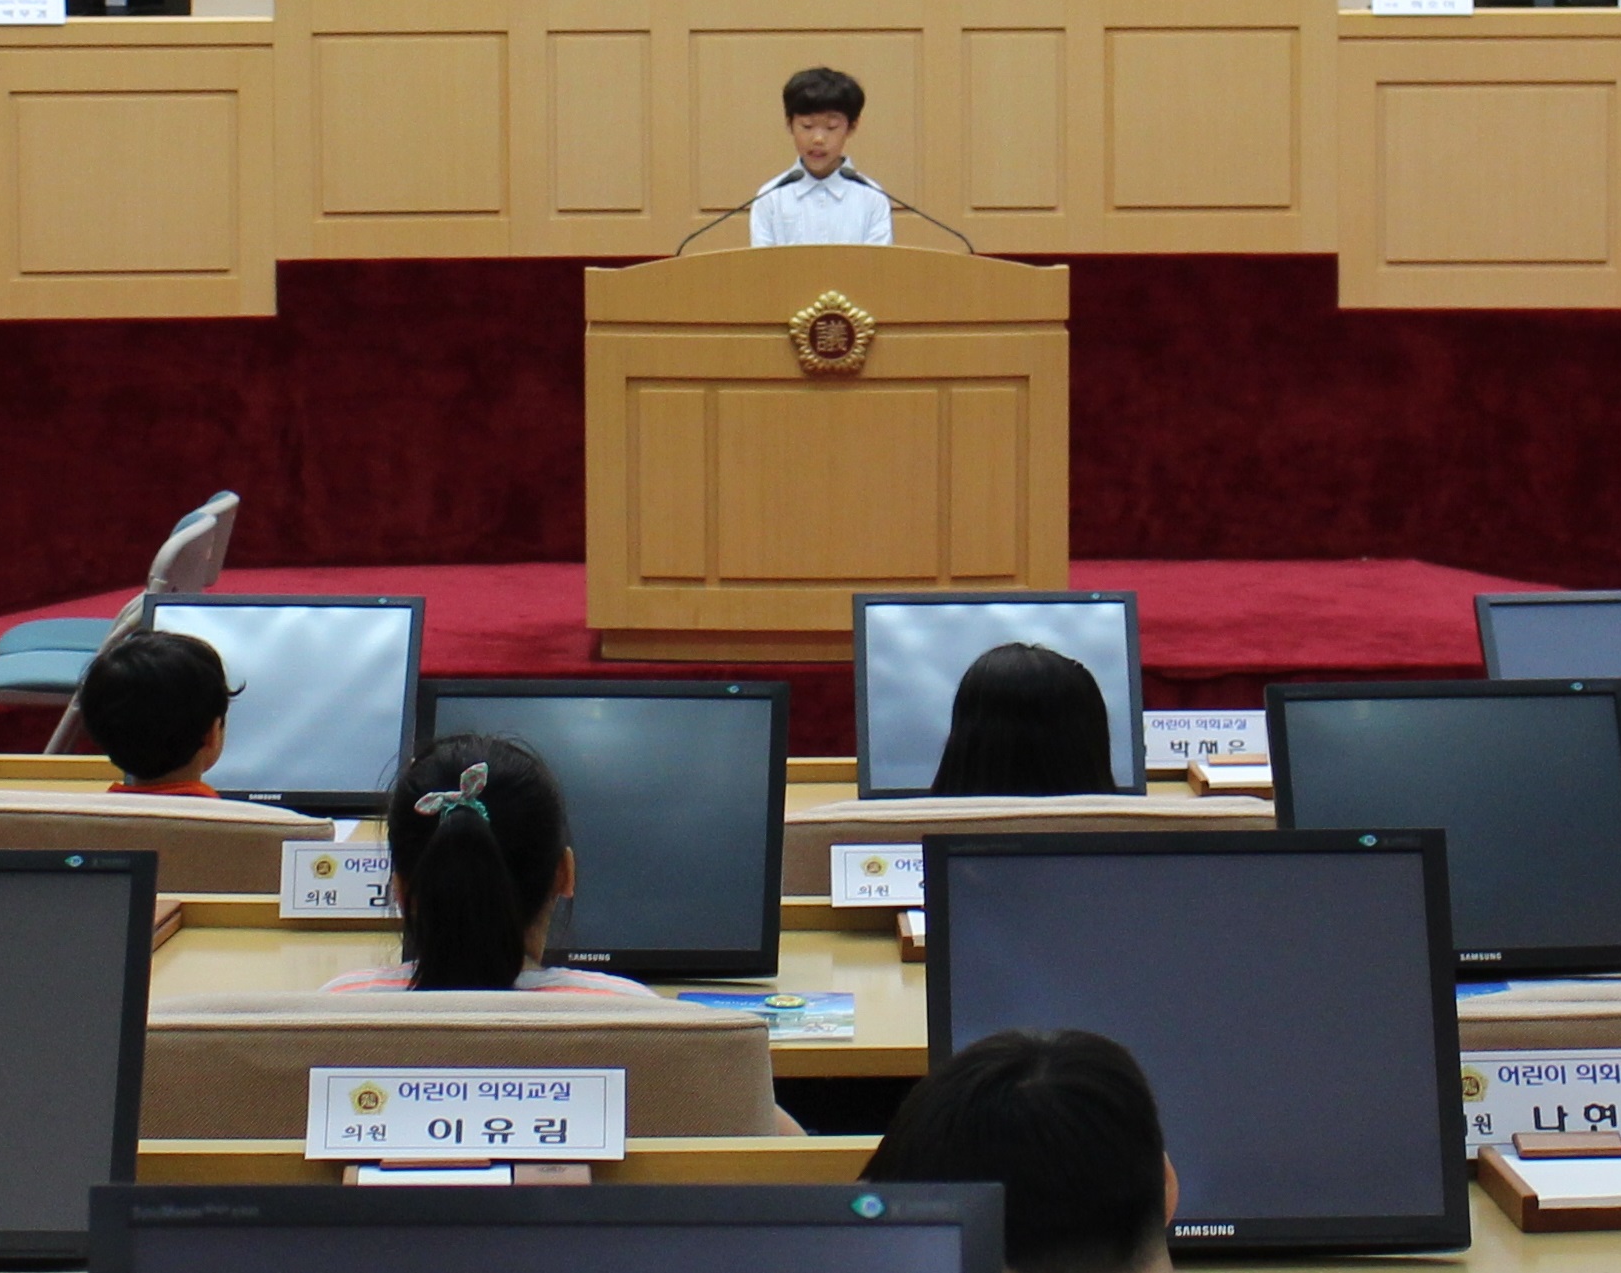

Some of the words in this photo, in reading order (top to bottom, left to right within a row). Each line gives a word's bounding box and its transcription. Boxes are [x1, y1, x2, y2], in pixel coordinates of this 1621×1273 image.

[1152, 718, 1190, 731] 어린이
[305, 889, 338, 906] 의원
[1460, 952, 1502, 962] SAMSUNG
[1497, 1065, 1566, 1086] 어린이
[398, 1081, 468, 1101] 어린이
[341, 1124, 387, 1142] 의원
[427, 1118, 568, 1144] 이유림
[1175, 1224, 1235, 1236] SAMSUNG
